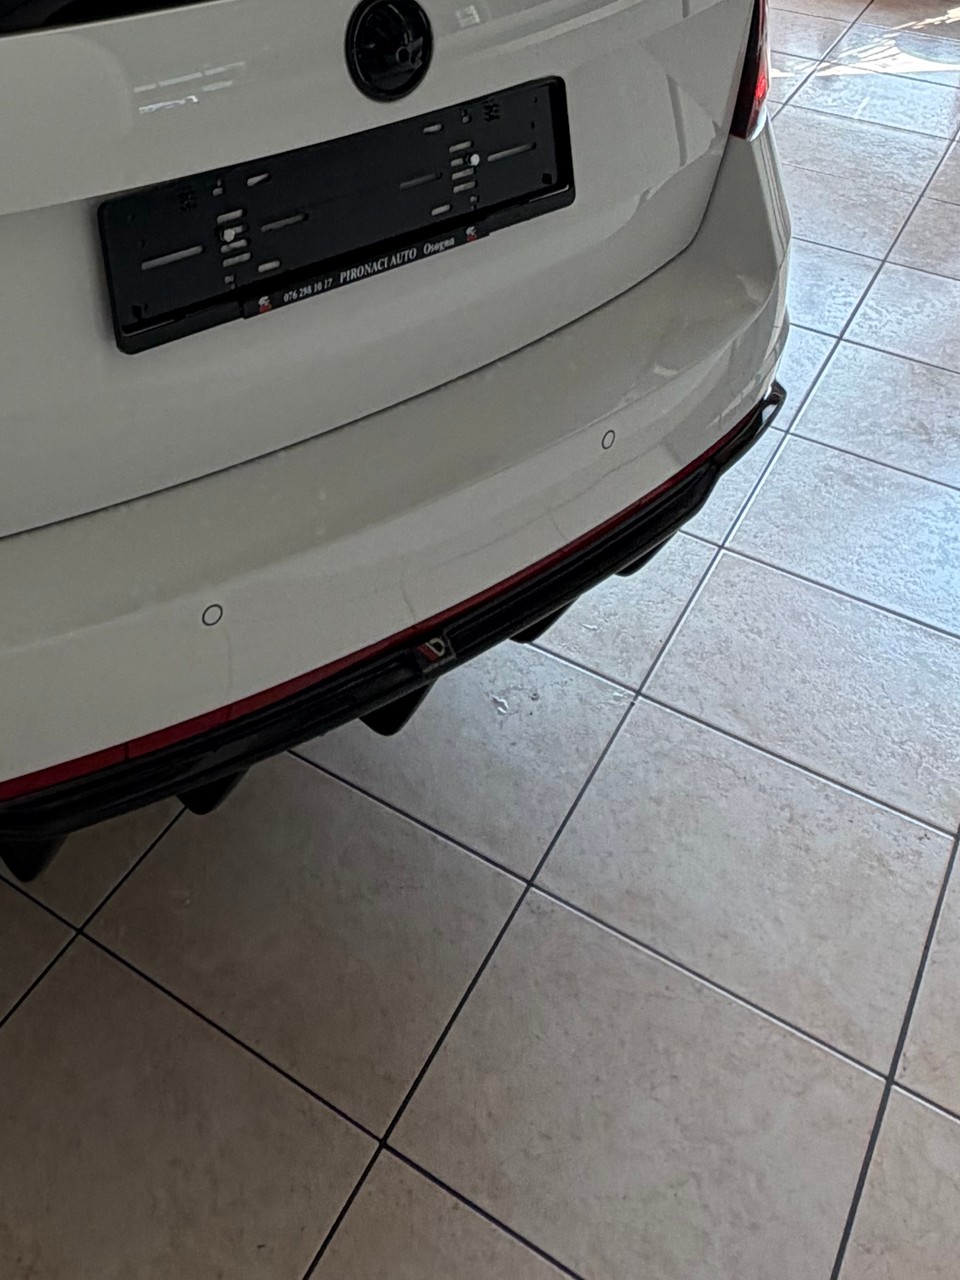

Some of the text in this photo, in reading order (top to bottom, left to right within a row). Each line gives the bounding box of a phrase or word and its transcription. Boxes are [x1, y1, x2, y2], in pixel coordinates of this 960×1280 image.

[339, 257, 389, 284] PIRONACI
[389, 247, 417, 267] AUTO
[423, 236, 455, 256] Osogna
